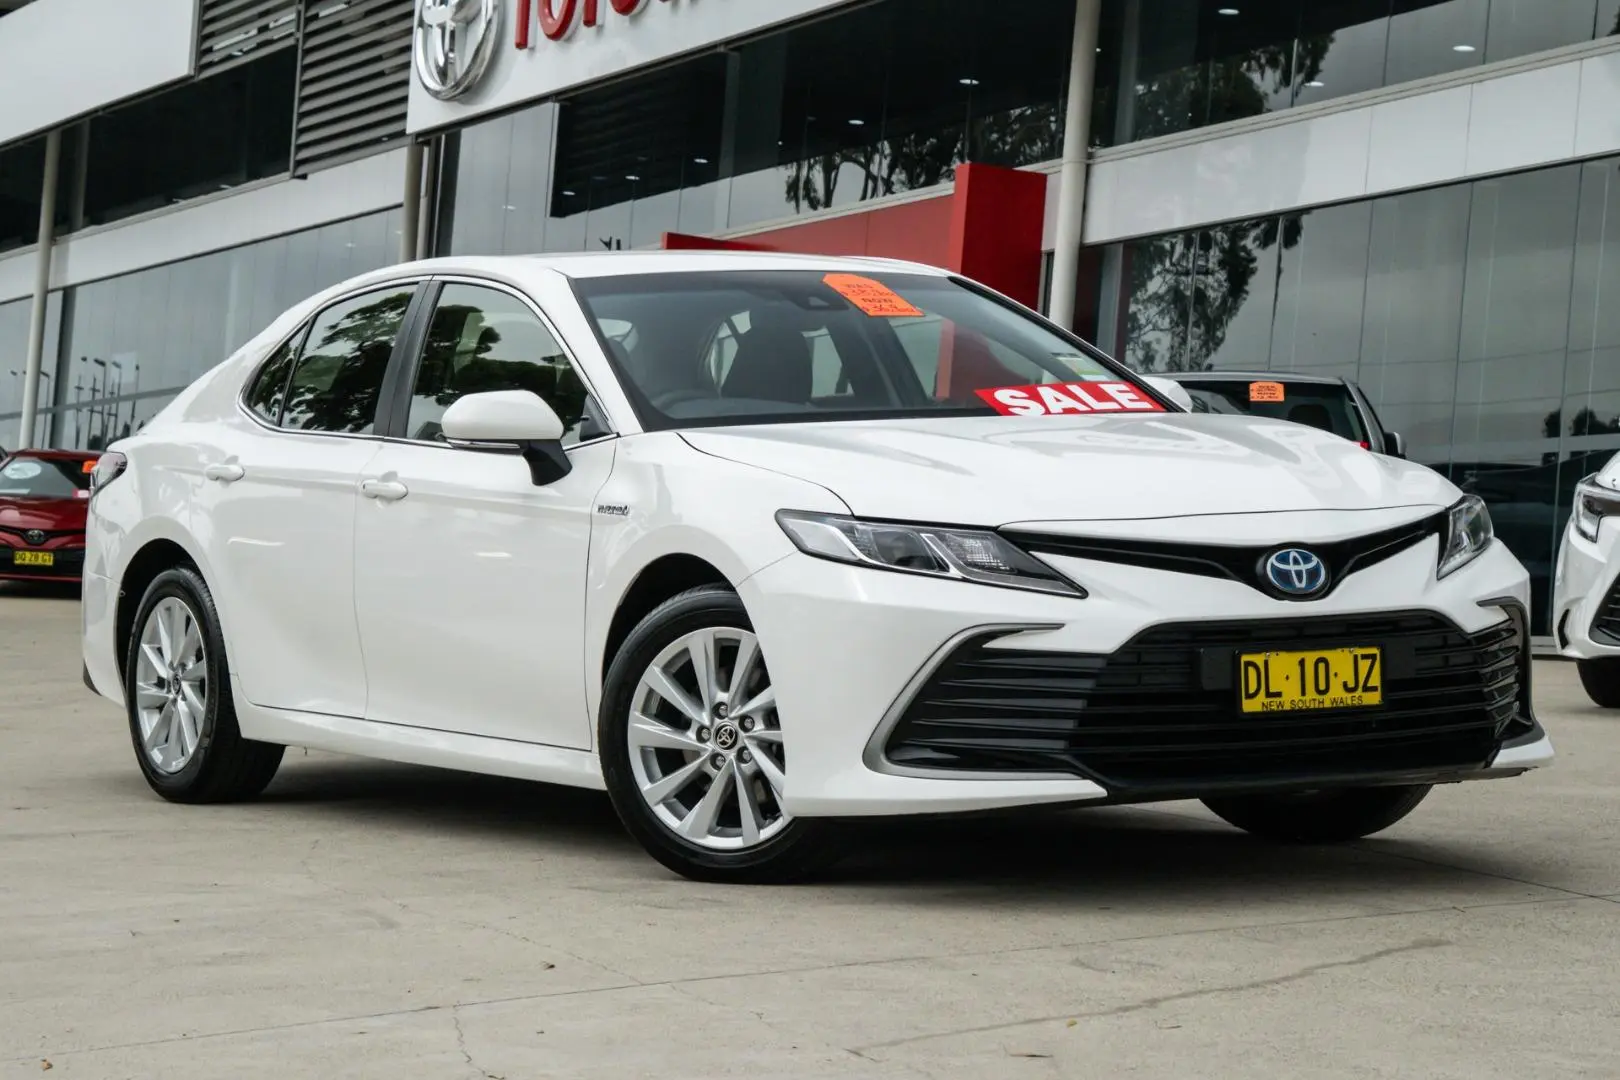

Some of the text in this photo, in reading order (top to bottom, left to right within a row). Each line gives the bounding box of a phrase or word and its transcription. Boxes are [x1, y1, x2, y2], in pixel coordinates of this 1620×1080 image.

[993, 383, 1154, 416] SALE
[1261, 695, 1363, 711] NEW SOUTH WALES
